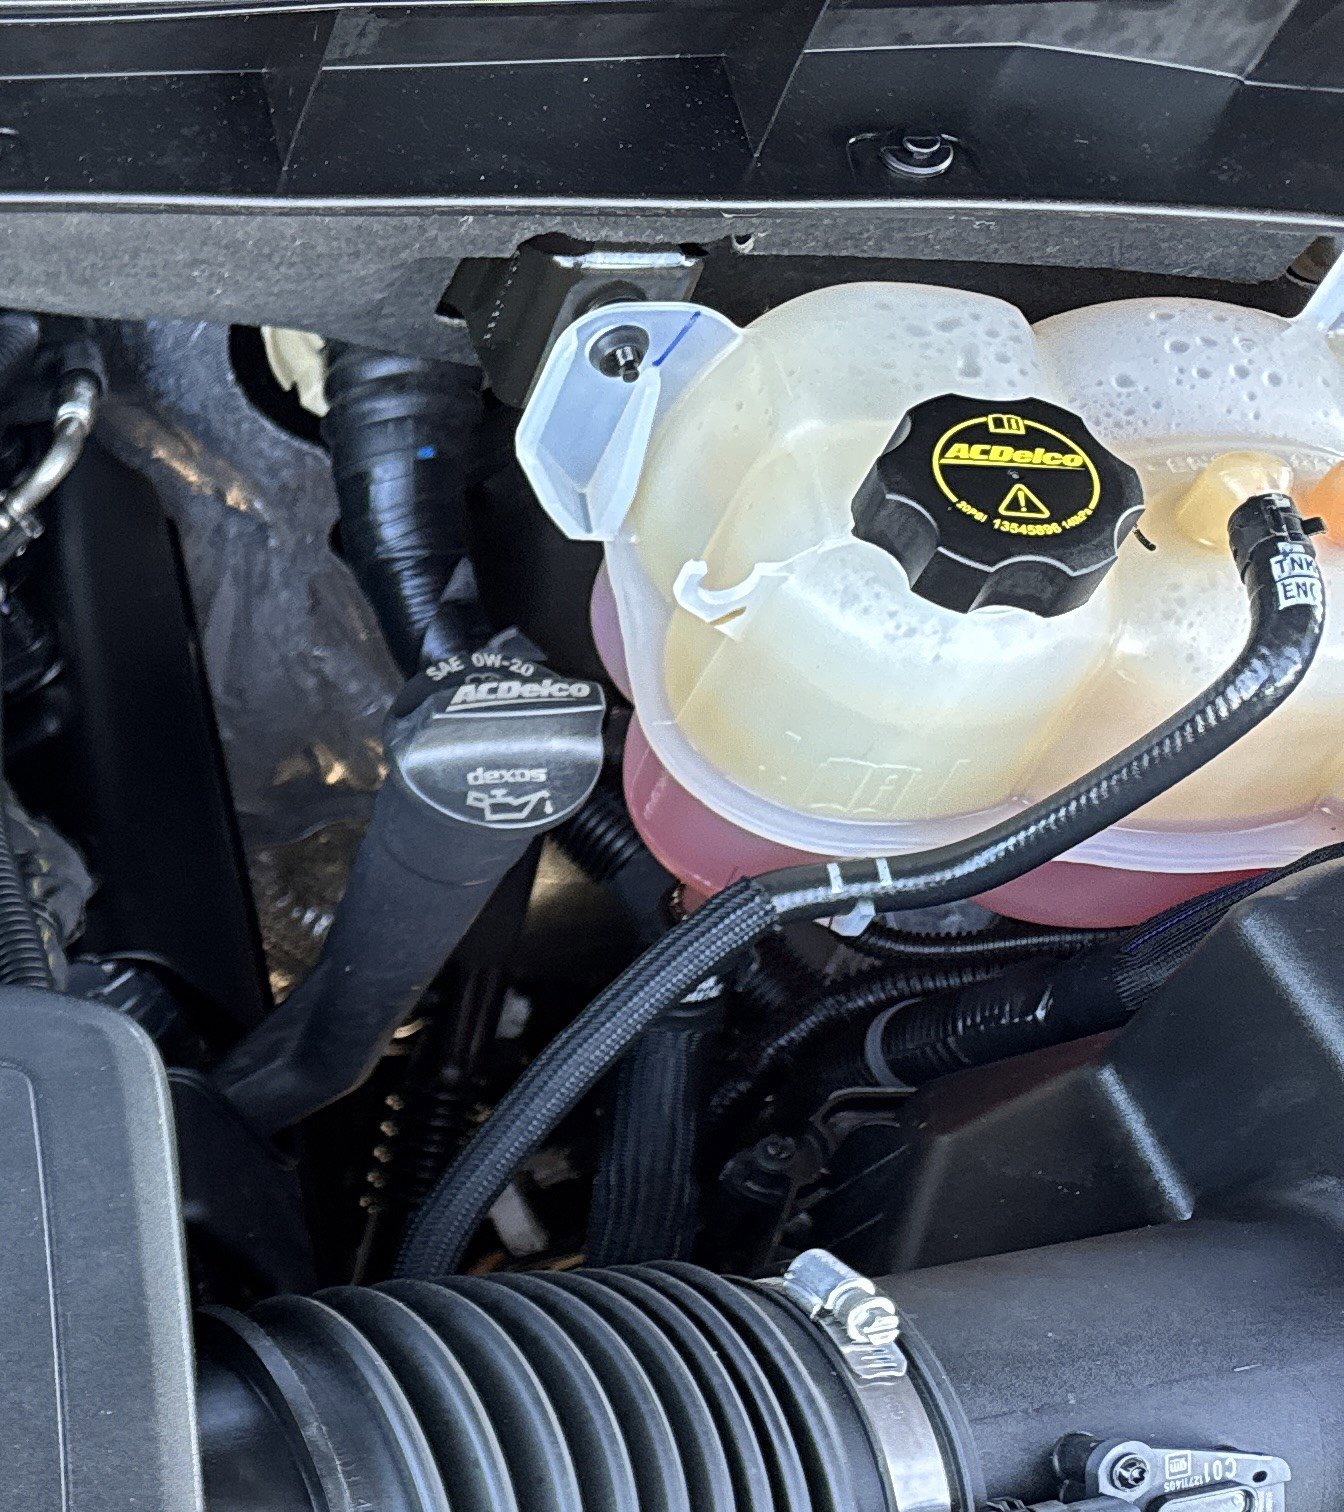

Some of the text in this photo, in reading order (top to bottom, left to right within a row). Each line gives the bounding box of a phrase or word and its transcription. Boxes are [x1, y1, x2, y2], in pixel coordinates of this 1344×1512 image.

[944, 443, 1085, 467] ACDelco
[426, 652, 534, 681] SAE 0W-20
[451, 678, 590, 704] ACDelco
[467, 767, 547, 786] dexos
